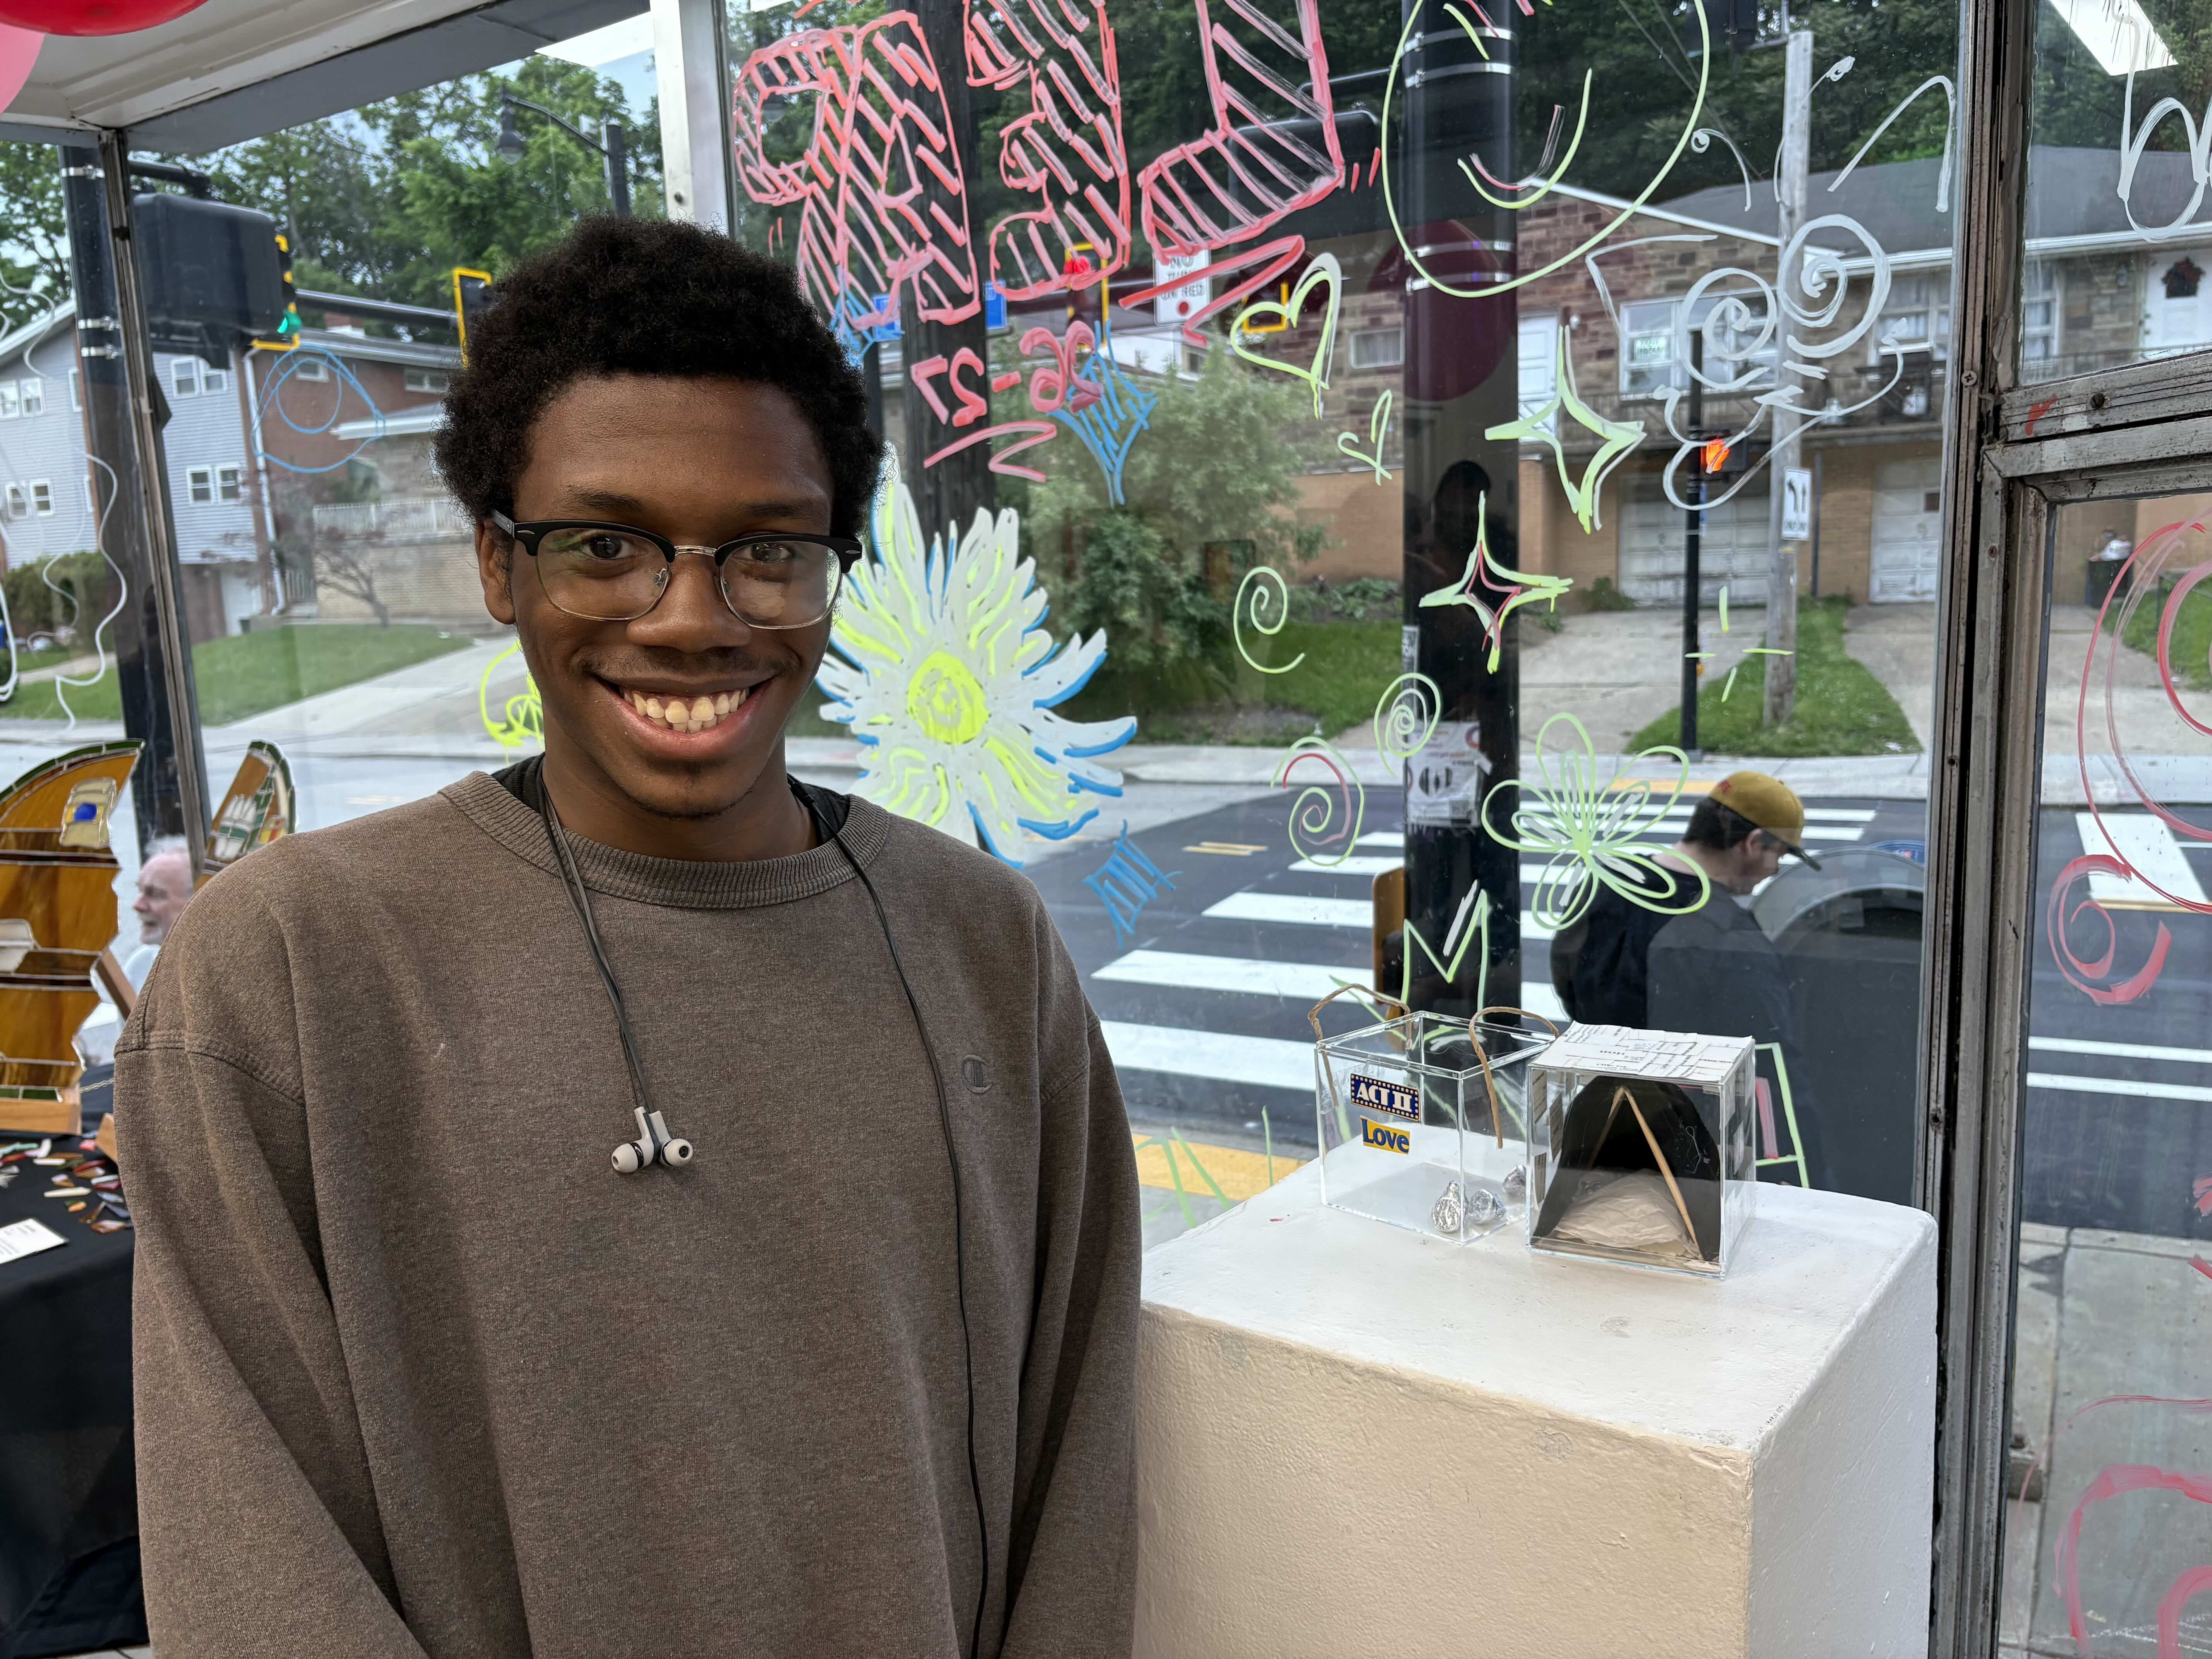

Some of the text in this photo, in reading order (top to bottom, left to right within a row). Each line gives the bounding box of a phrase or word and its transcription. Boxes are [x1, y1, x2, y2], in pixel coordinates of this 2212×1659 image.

[1182, 284, 1205, 297] RED
[1357, 1083, 1412, 1112] ACT II
[1361, 1118, 1410, 1153] Love
